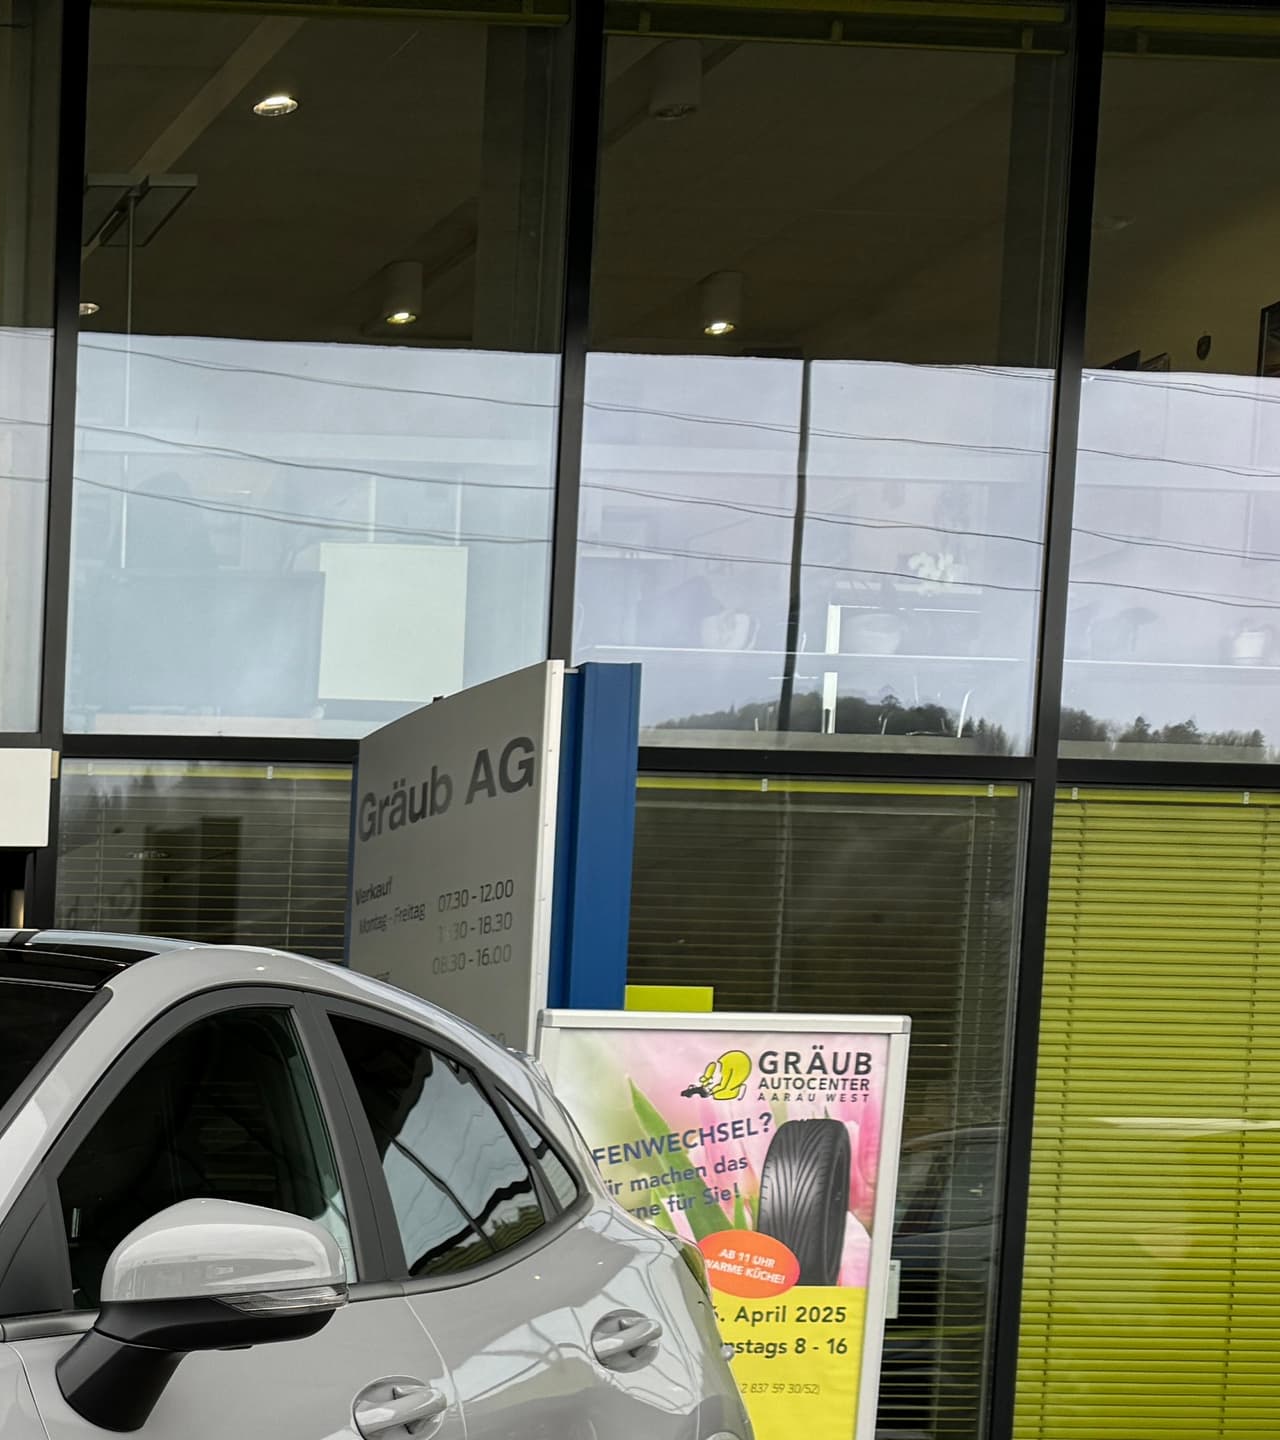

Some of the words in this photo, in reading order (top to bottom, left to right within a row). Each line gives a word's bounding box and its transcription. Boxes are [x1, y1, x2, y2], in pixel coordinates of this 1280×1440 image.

[357, 766, 454, 843] Gräub
[464, 735, 537, 806] AG
[355, 875, 393, 906] Verkauf
[394, 903, 426, 925] Freitag
[479, 879, 514, 903] 12.00
[477, 911, 513, 936] 18.30
[476, 943, 512, 968] 16.00
[757, 1044, 873, 1077] GRÄUB
[757, 1077, 870, 1091] AUTOCENTER
[757, 1092, 817, 1103] AARAU
[825, 1093, 871, 1103] WEST
[604, 1178, 623, 1196] ir
[630, 1166, 707, 1193] machen
[714, 1155, 748, 1175] das
[666, 1189, 698, 1213] für
[703, 1182, 739, 1206] Sie!
[718, 1248, 736, 1259] AB
[738, 1252, 750, 1262] 11
[752, 1256, 775, 1268] UHR
[704, 1259, 744, 1275] WARME
[745, 1267, 786, 1285] KÜCHE!
[734, 1305, 787, 1328] April
[795, 1305, 847, 1323] 2025
[794, 1337, 807, 1354] 8
[827, 1337, 848, 1355] 16
[750, 1382, 769, 1394] 837
[771, 1383, 786, 1394] 59
